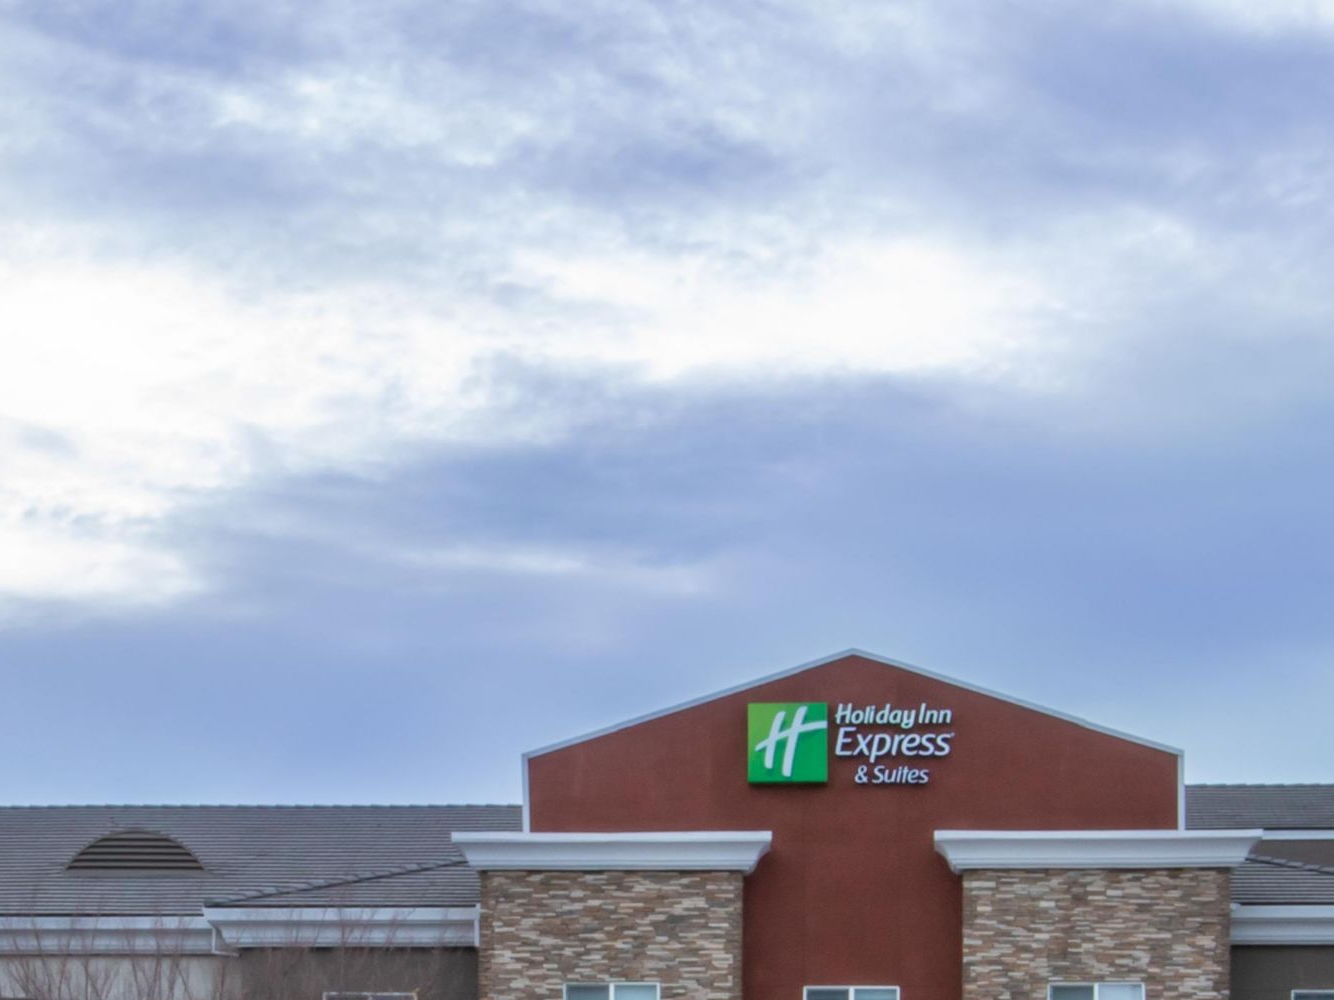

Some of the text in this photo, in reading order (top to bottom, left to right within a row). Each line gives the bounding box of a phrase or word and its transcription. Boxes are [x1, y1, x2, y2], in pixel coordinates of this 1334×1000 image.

[835, 703, 952, 729] Holiday Inn
[835, 727, 951, 763] Express
[854, 765, 929, 784] & Suites
